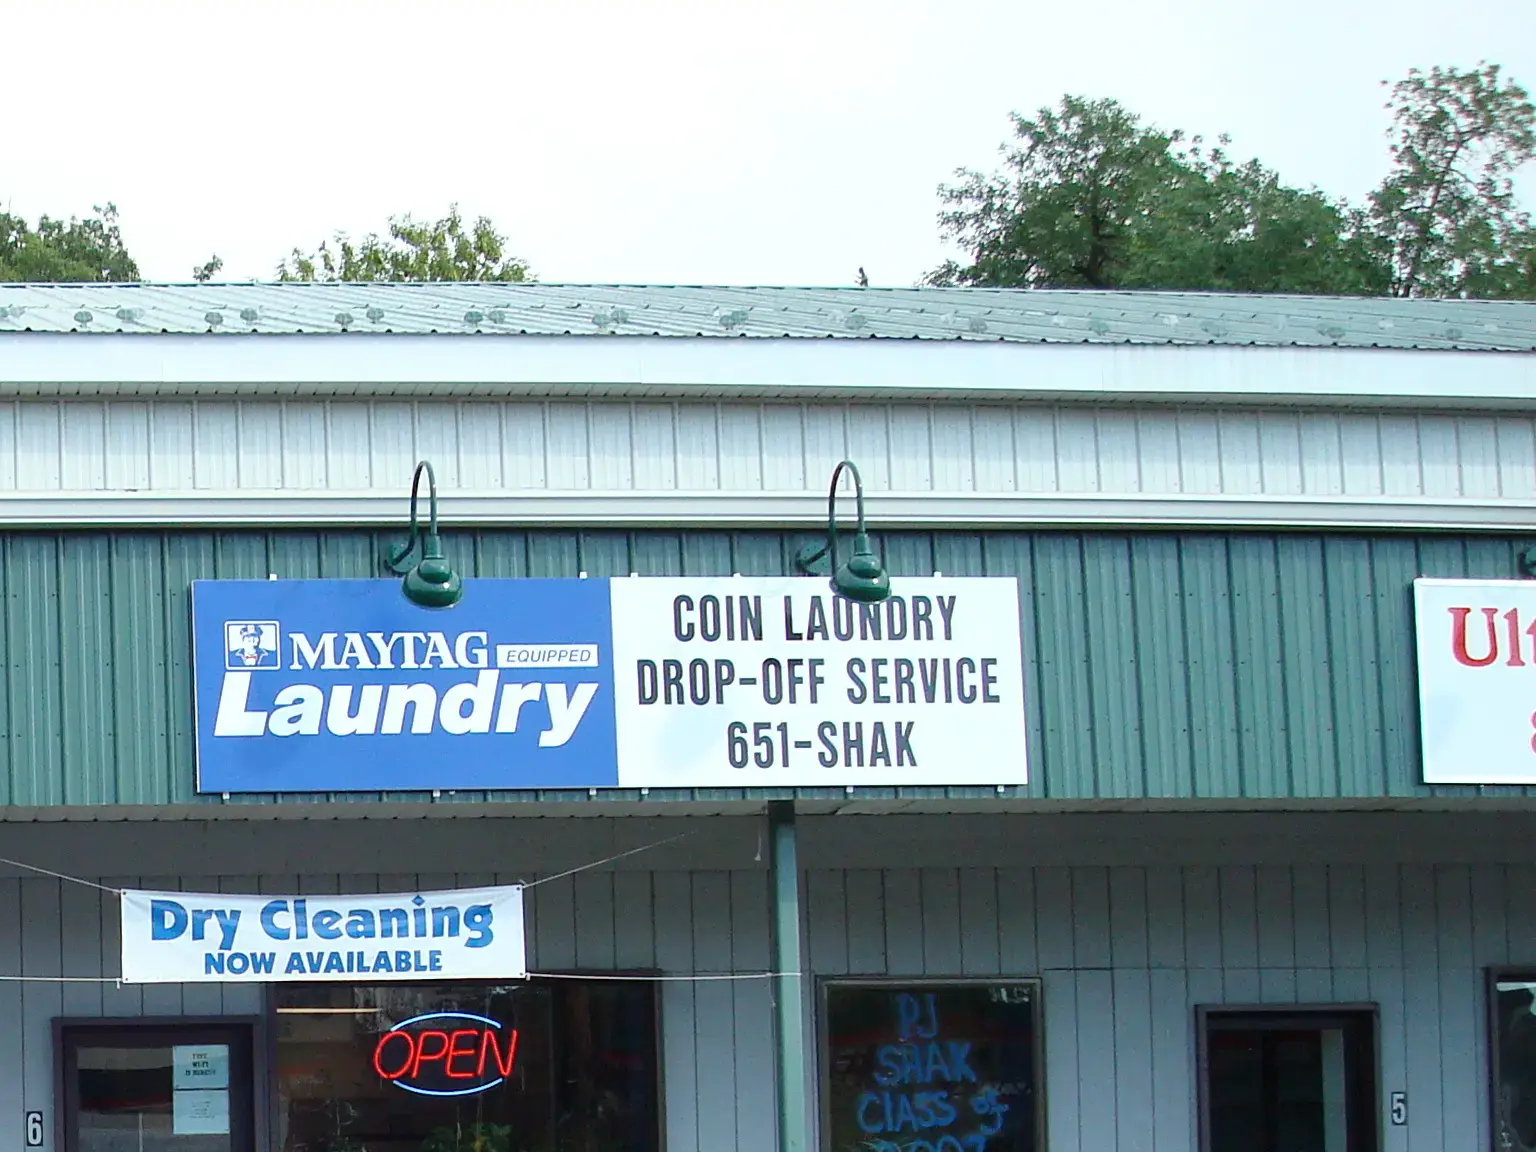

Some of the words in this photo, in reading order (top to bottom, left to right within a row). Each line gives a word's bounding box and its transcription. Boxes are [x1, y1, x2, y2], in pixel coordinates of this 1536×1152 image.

[673, 594, 763, 642] COIN
[784, 594, 957, 642] LAUNDRY
[288, 631, 489, 670] MAYTAG
[505, 649, 591, 663] EQUIPPED
[636, 657, 825, 706] DROP-OFF
[846, 657, 1000, 705] SERVICE
[214, 670, 599, 747] Laundry
[727, 721, 917, 769] 651-SHAK
[149, 898, 242, 952] Dry
[259, 895, 495, 949] Cleaning
[204, 952, 276, 975] NOW
[285, 949, 442, 974] AVAILABLE
[373, 1029, 518, 1079] OPEN
[872, 1040, 977, 1087] SHAK
[27, 1113, 43, 1145] 6
[968, 1087, 1010, 1135] of
[1392, 1093, 1406, 1124] 5
